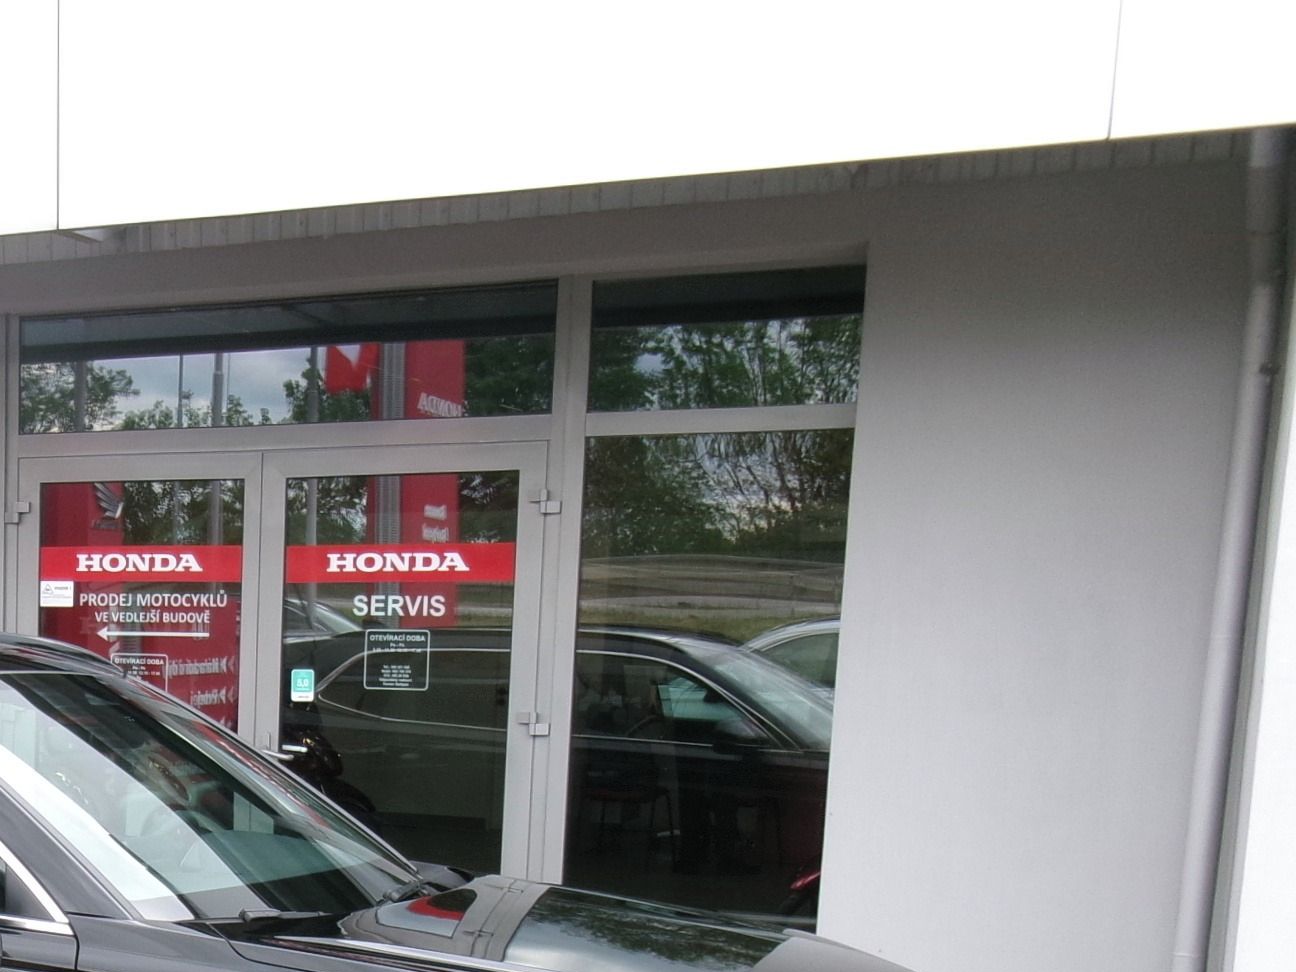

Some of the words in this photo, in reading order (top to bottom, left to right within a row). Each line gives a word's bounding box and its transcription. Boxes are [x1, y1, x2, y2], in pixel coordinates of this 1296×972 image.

[76, 552, 203, 573] HONDA
[326, 552, 470, 572] HONDA
[79, 593, 132, 607] PRODEJ
[136, 589, 227, 607] MOTOCYKLŮ
[352, 594, 446, 617] SERVIS
[94, 612, 109, 622] VE
[111, 610, 161, 623] VEDLEJŠÍ
[162, 610, 211, 624] BUDOVĚ
[369, 633, 405, 641] OTEVÍRACÍ
[114, 656, 146, 665] OTEVÍRACÍ
